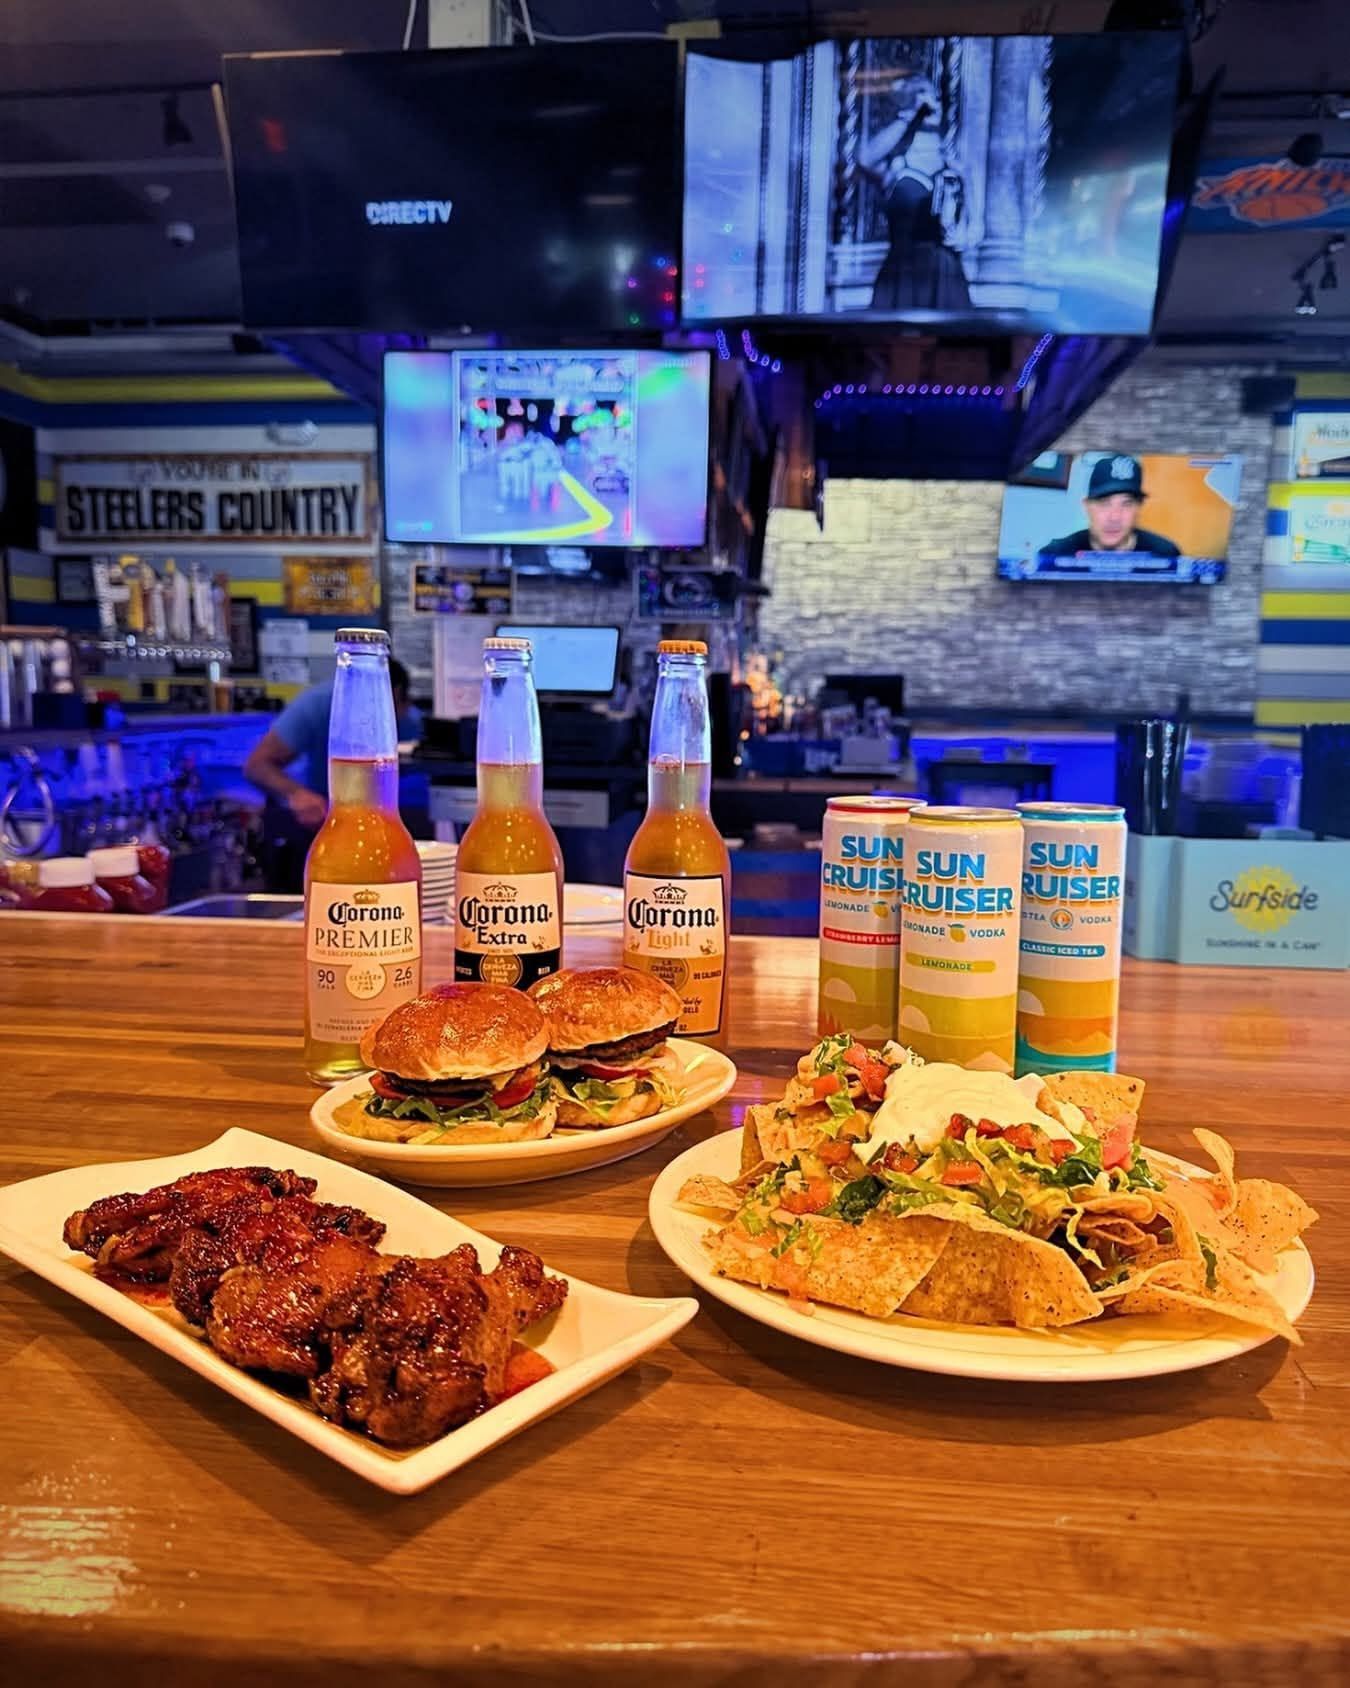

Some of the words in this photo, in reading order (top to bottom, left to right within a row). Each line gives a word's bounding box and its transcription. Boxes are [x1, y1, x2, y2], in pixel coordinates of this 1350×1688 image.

[366, 200, 453, 225] DIRECTV
[240, 460, 261, 480] IN
[66, 484, 206, 532] STEELERS
[217, 483, 361, 535] COUNTRY
[840, 834, 904, 861] SUN
[1029, 841, 1099, 869] SUN
[822, 861, 904, 892] CRUIS
[916, 850, 986, 880] SUN
[1021, 872, 1121, 900] RUISER
[1209, 879, 1319, 912] Surfside
[328, 901, 405, 927] Corona
[458, 895, 552, 932] Corona
[628, 896, 719, 933] Corona
[824, 899, 870, 913] LEMONADE
[1079, 915, 1112, 924] VODKA
[315, 926, 413, 949] PREMIER
[477, 926, 528, 945] Extra
[646, 929, 691, 950] Light
[969, 928, 1006, 938] VODKA
[1021, 942, 1056, 954] CLASSIC
[1058, 946, 1080, 955] ICED
[1082, 947, 1098, 955] TEA
[317, 969, 336, 984] 90
[394, 966, 413, 982] 2.6
[921, 958, 972, 971] LEMONADE
